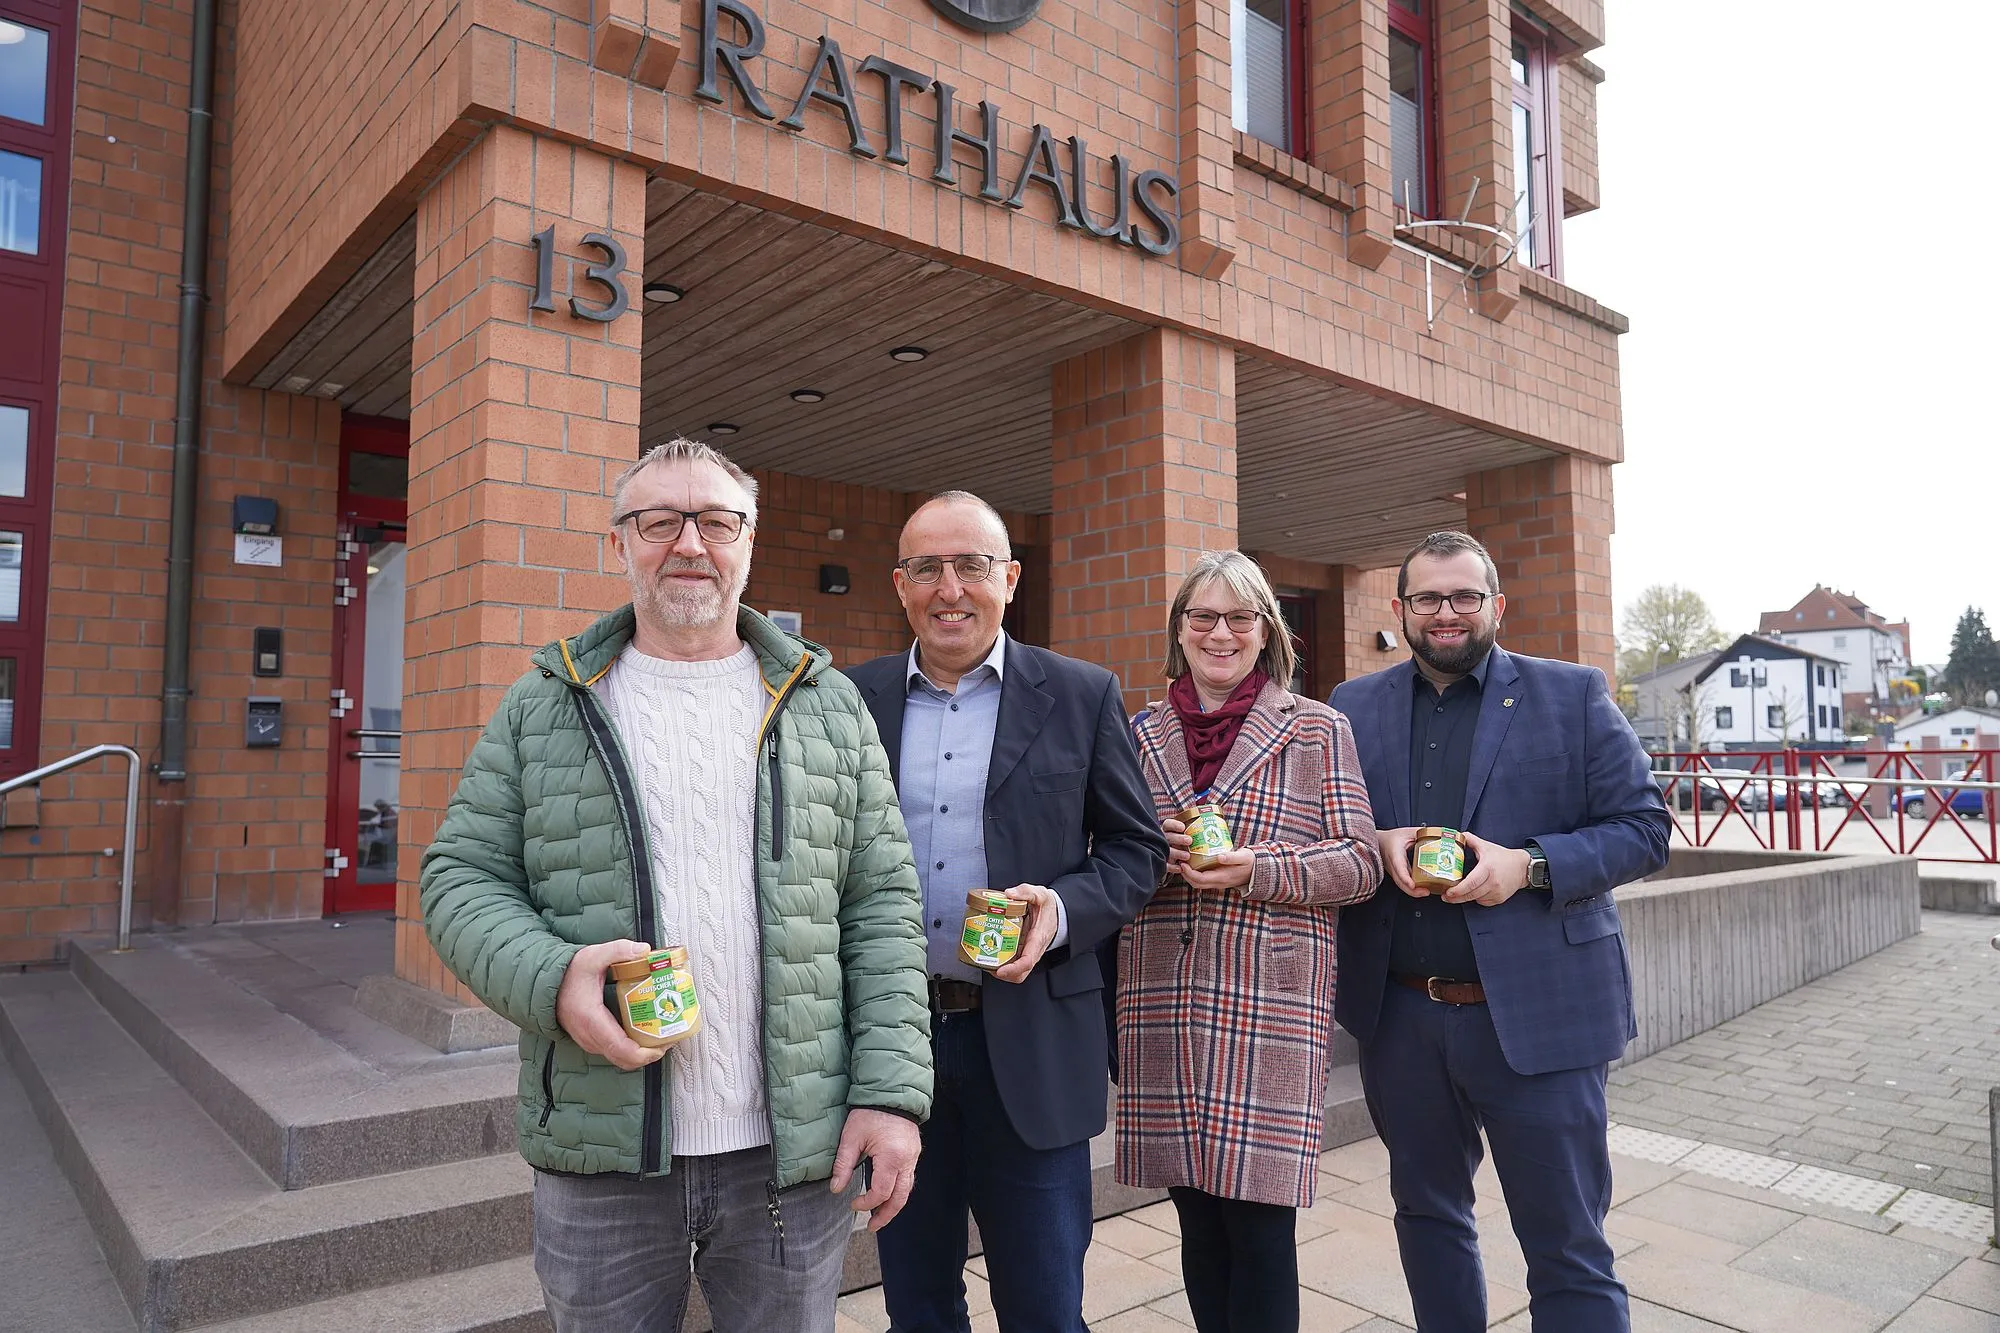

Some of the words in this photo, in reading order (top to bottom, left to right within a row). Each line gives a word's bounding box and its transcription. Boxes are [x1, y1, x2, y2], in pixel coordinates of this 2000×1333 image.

[695, 0, 1179, 256] RATHAUS
[529, 224, 629, 322] 13
[243, 535, 275, 547] Eingang
[652, 974, 675, 985] ECHTER
[639, 982, 672, 995] DEUTSCHER
